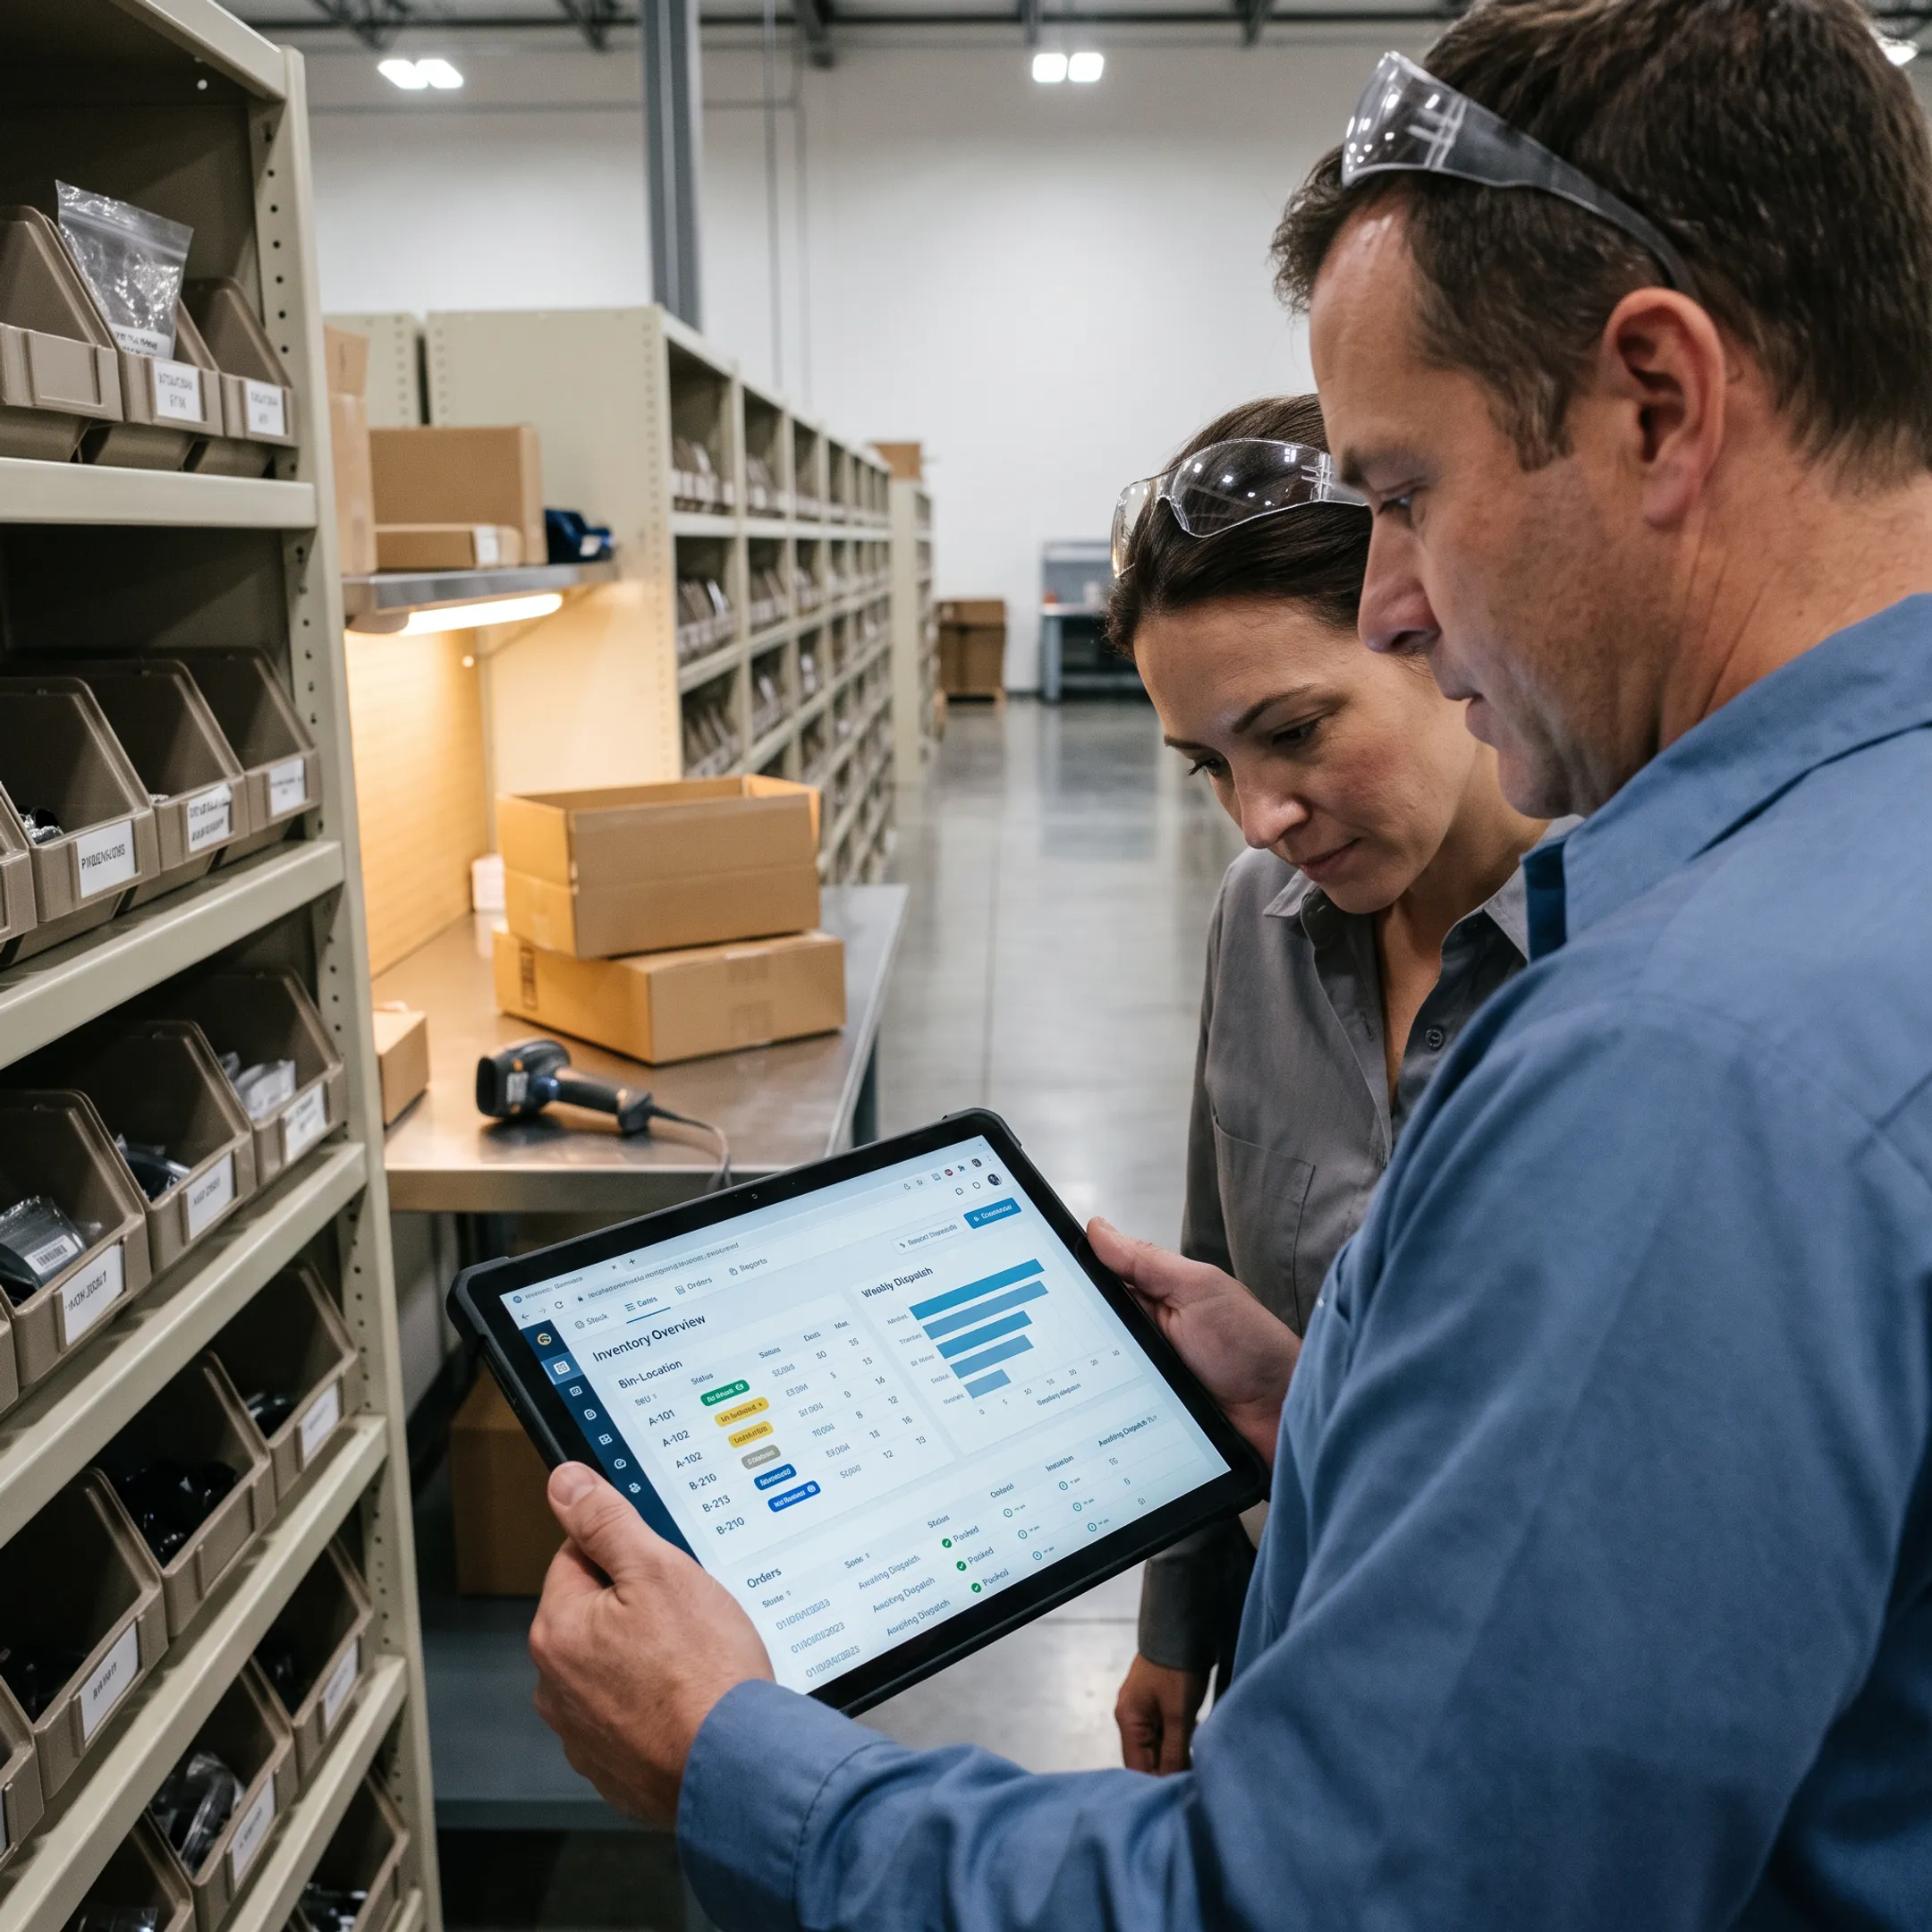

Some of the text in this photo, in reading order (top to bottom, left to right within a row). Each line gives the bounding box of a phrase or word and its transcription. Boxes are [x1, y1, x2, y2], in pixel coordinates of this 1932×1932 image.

[685, 1276, 713, 1290] Orders
[591, 1314, 706, 1362] Inventory Overview
[617, 1360, 683, 1389] Bin-Location
[886, 1394, 899, 1405] 12
[648, 1408, 675, 1427] A-101
[661, 1428, 691, 1448] A-102
[674, 1451, 703, 1469] A-102
[882, 1448, 894, 1459] 12
[687, 1472, 717, 1491] B-210
[700, 1494, 731, 1513] B-213
[715, 1515, 745, 1535] B-210
[745, 1567, 782, 1589] Orders
